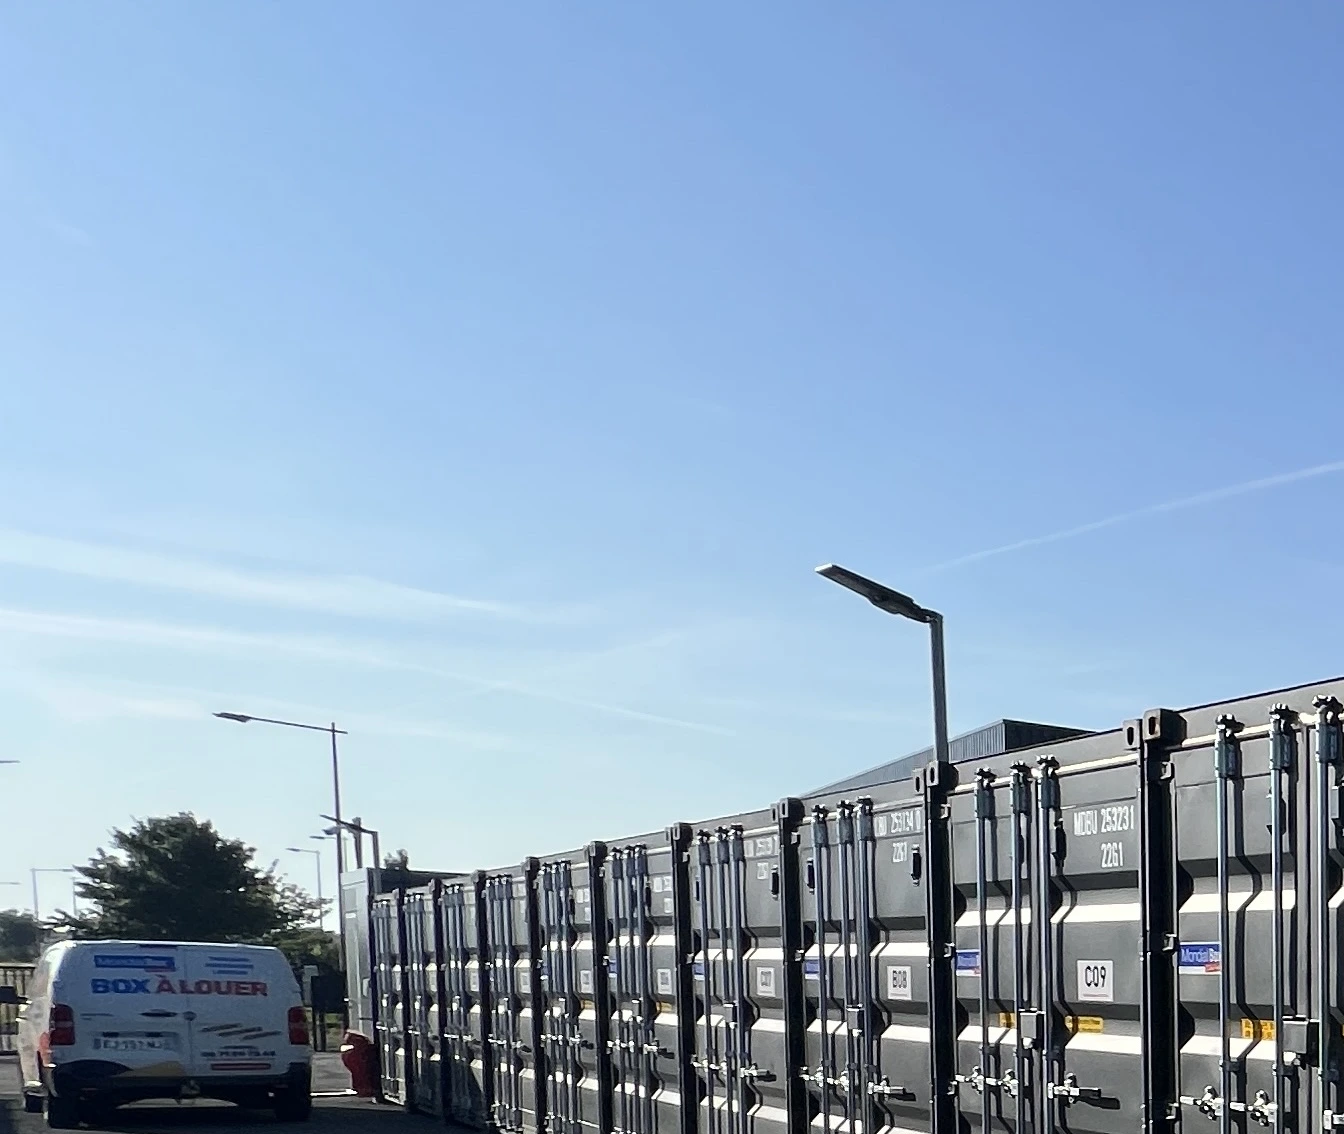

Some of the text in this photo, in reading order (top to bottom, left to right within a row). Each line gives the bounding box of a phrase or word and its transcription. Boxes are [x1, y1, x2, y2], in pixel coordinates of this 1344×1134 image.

[1073, 804, 1135, 836] MDBU 253231
[91, 978, 150, 994] BOX
[179, 979, 268, 997] LOUER
[1084, 965, 1107, 988] C09
